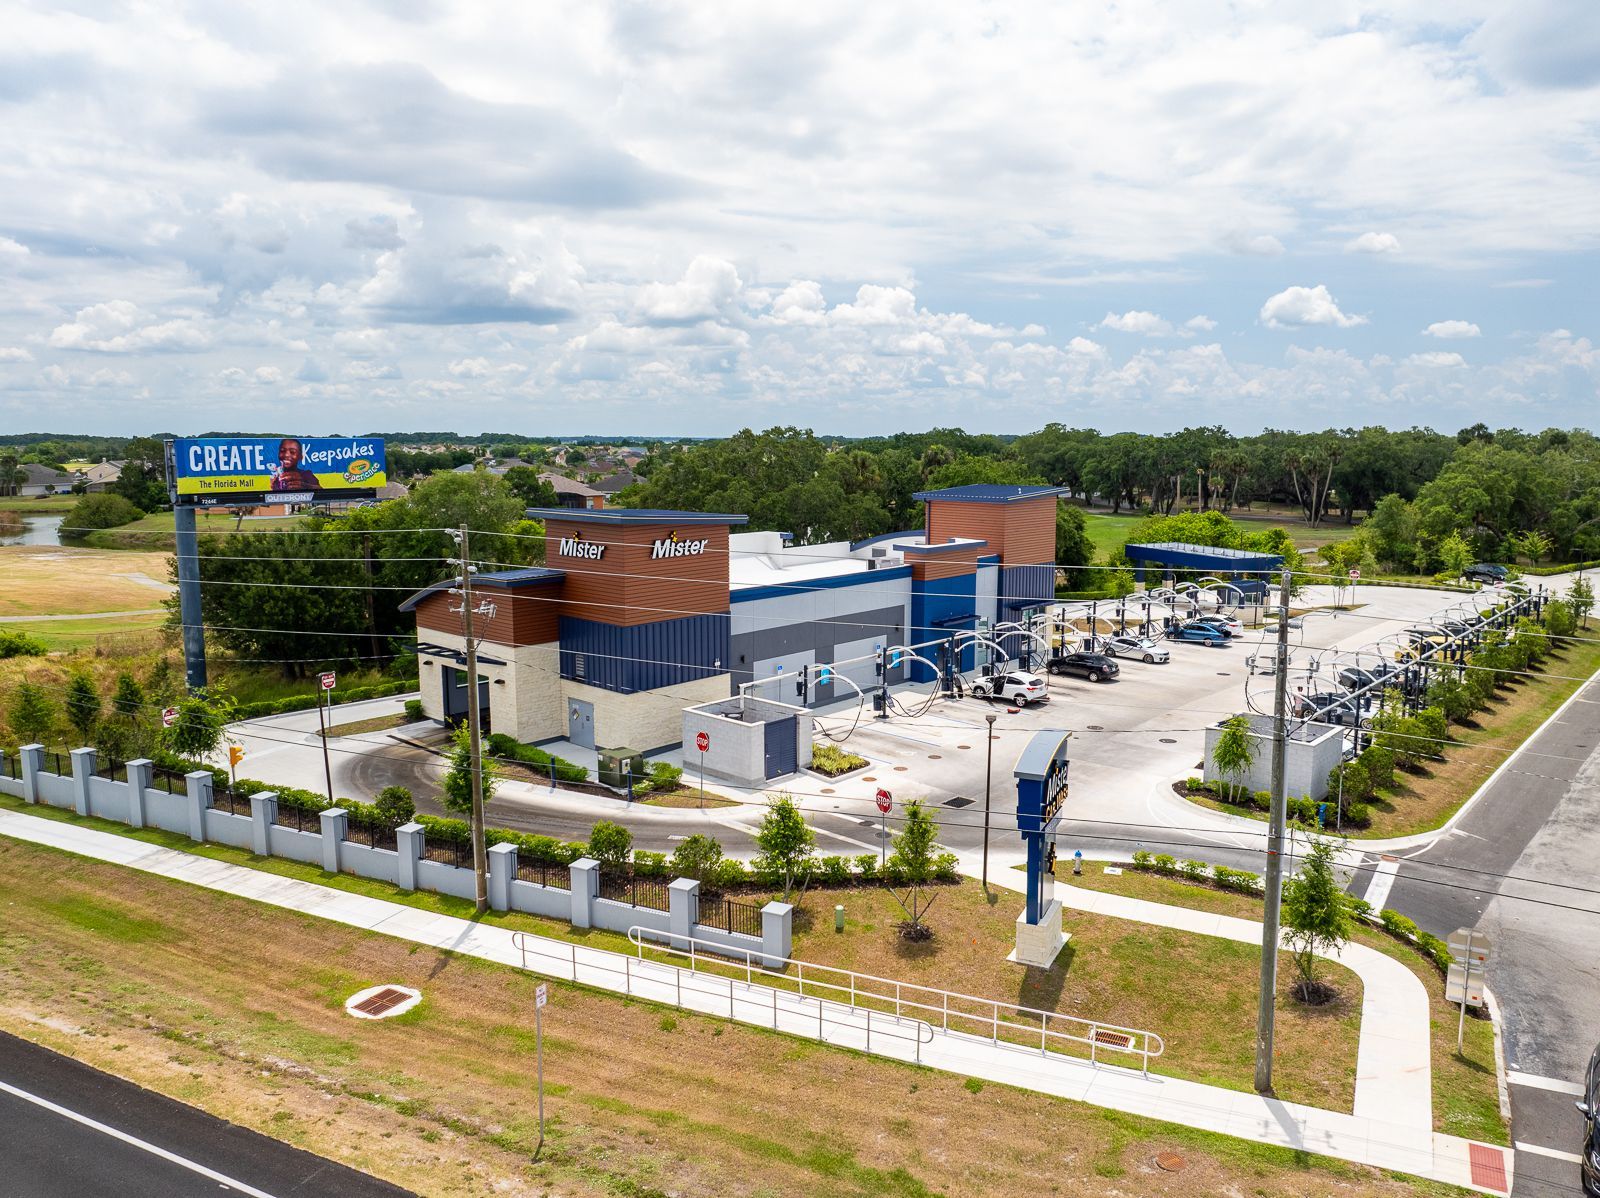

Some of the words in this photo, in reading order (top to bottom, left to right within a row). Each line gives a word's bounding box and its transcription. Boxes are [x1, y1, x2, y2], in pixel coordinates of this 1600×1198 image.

[189, 445, 265, 472] CREATE
[302, 442, 374, 466] Keepsakes
[214, 480, 237, 488] Florida
[240, 479, 254, 487] Mall
[559, 537, 605, 559] Mister
[652, 538, 708, 560] Mister
[696, 736, 709, 746] STOP
[877, 794, 891, 807] STOP
